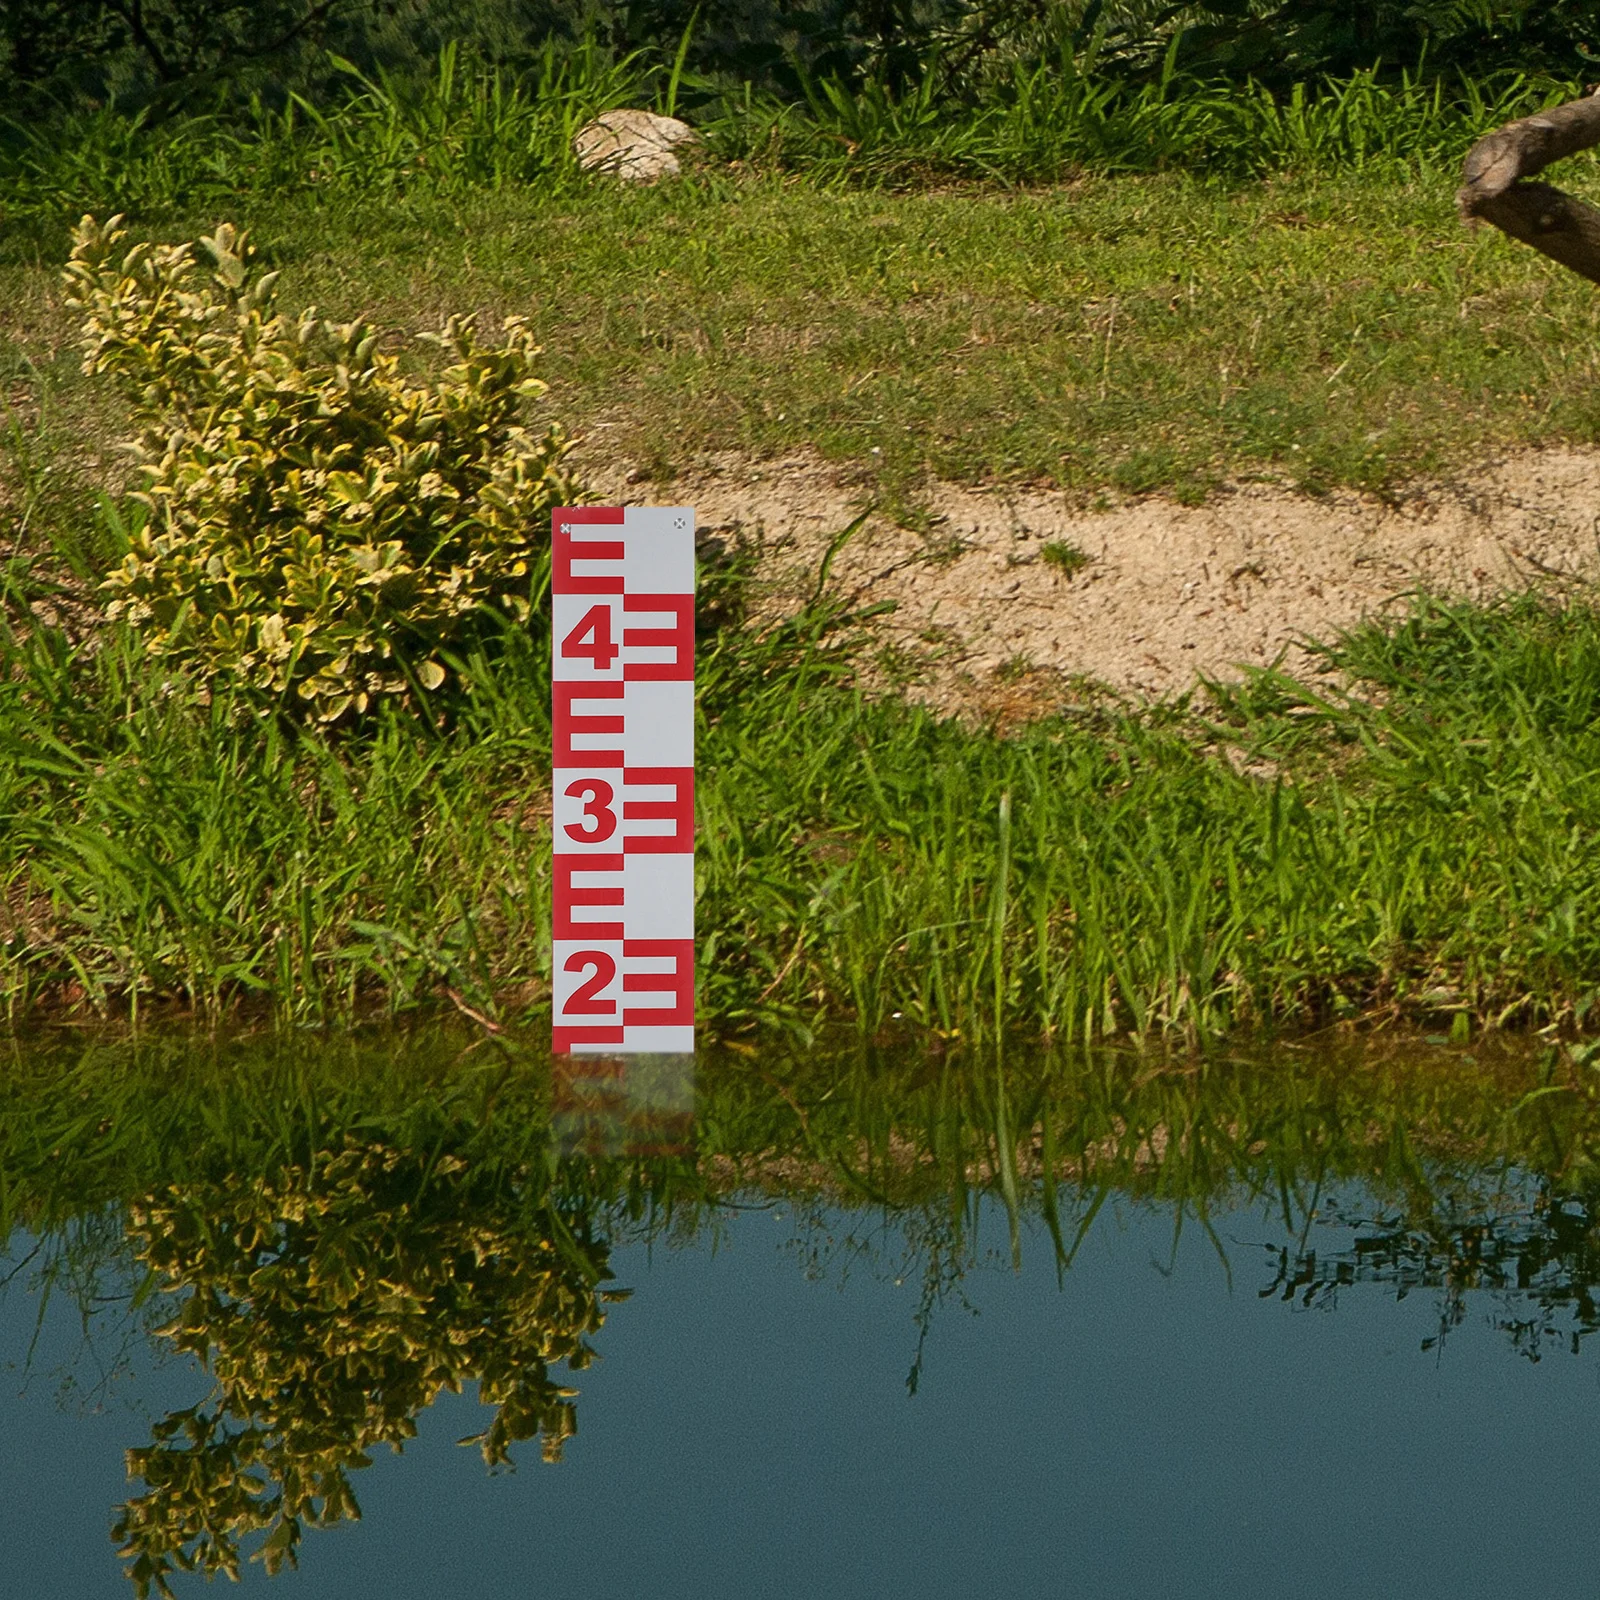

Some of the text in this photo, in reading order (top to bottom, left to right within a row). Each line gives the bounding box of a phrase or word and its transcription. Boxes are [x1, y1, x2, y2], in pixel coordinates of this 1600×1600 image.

[561, 604, 619, 670] 4
[563, 778, 617, 844] 3
[562, 950, 617, 1015] 2
